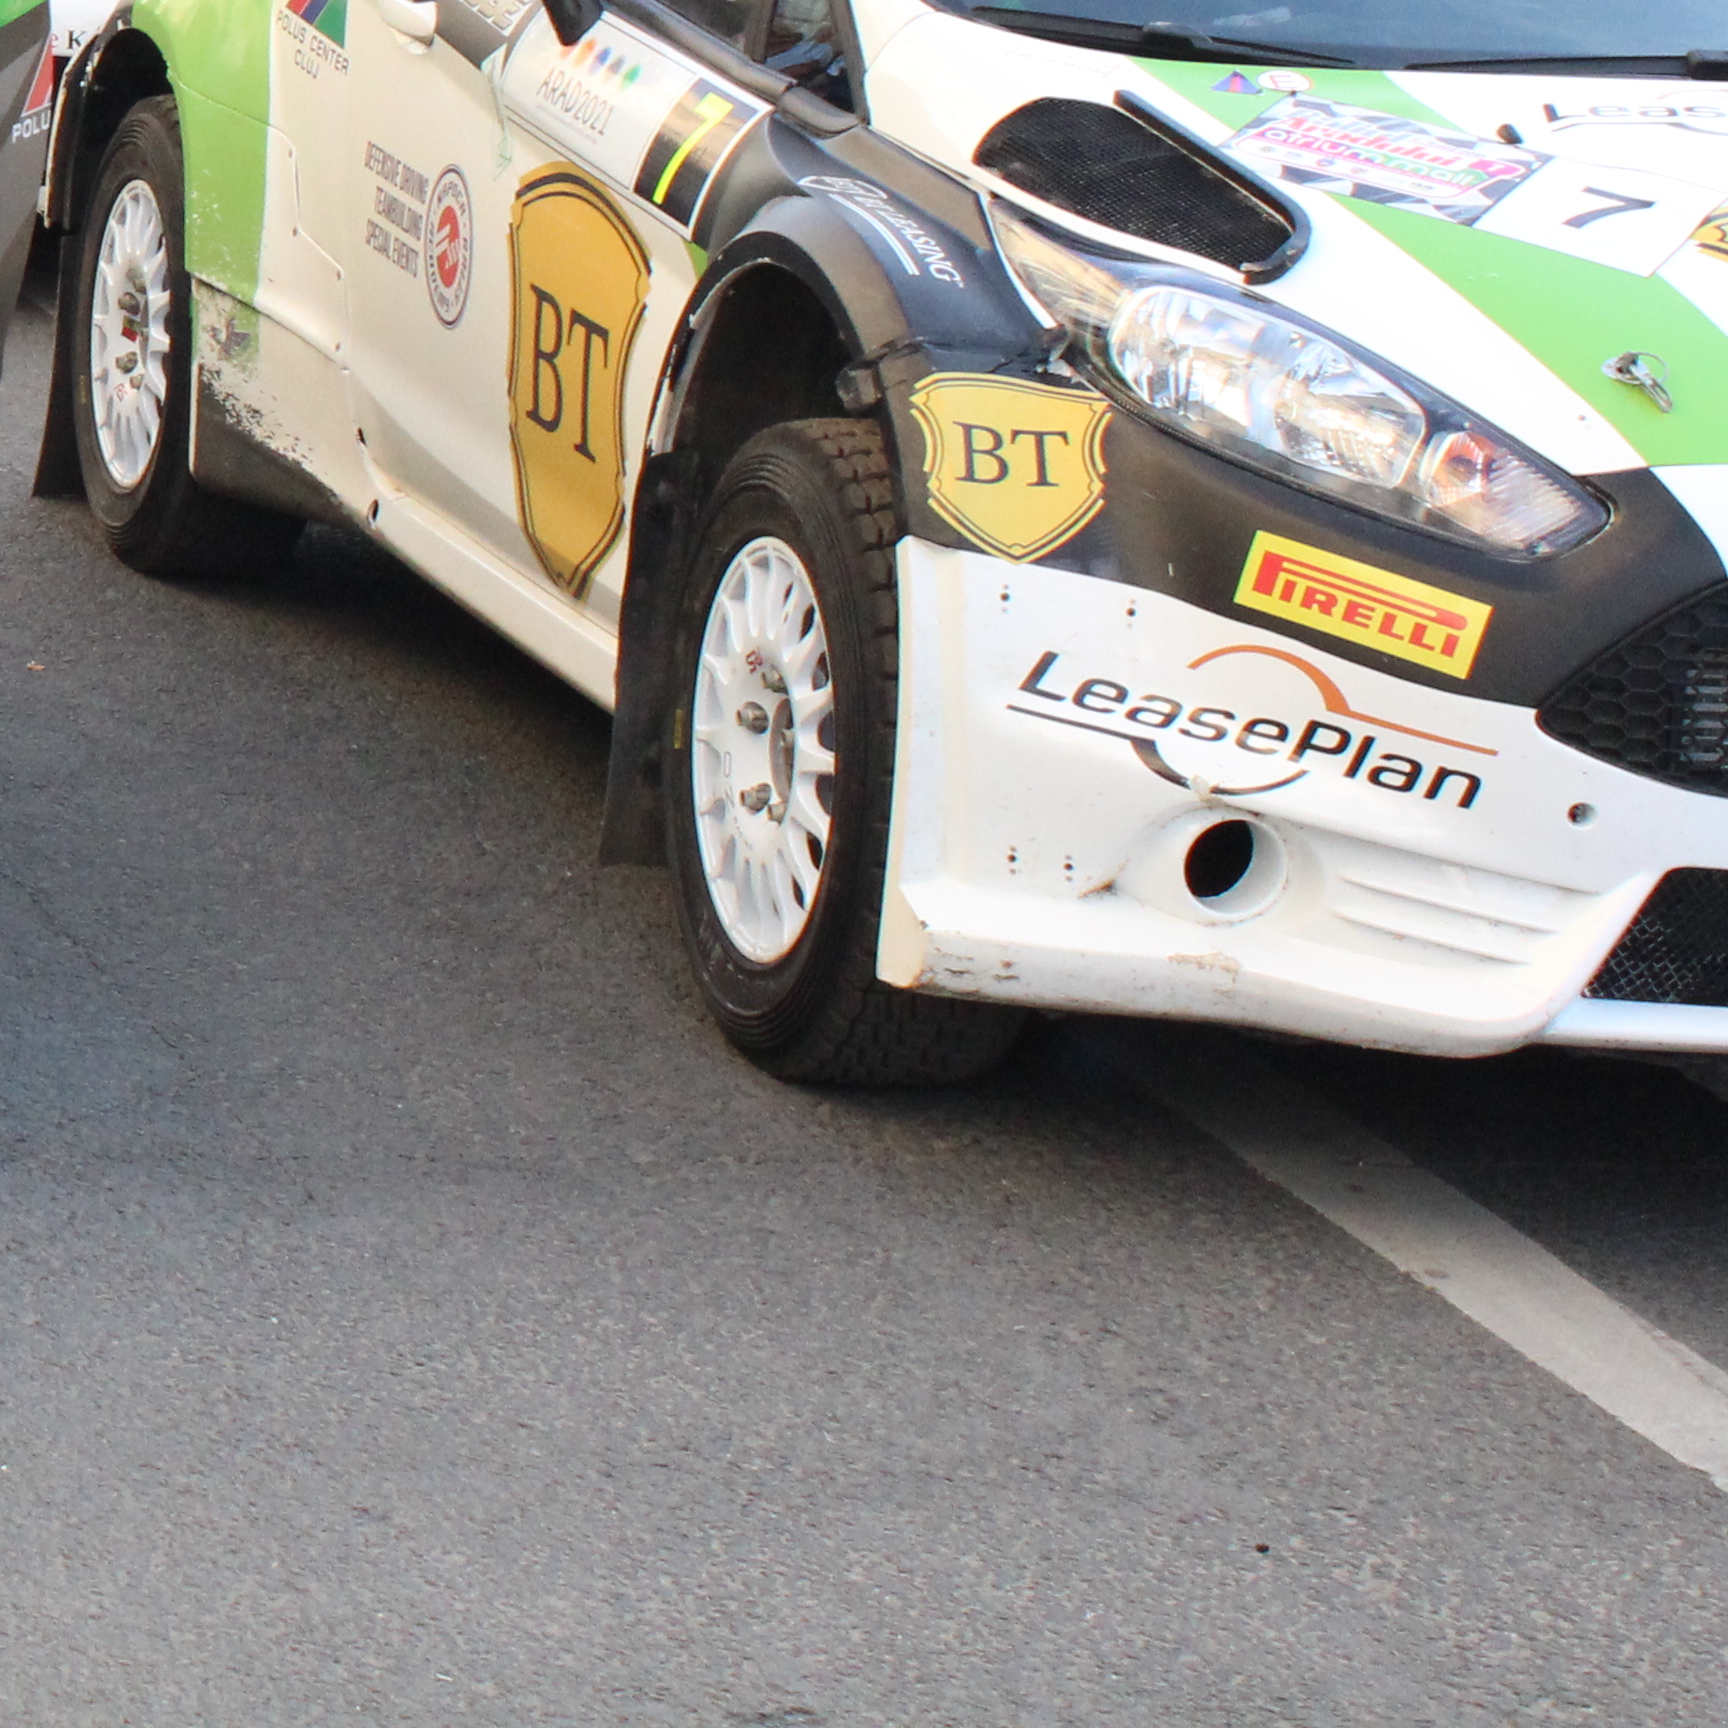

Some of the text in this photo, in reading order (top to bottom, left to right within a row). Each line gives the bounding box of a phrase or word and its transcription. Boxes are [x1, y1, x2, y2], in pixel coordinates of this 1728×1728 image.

[275, 8, 351, 77] POLUS CENTER
[294, 49, 320, 80] CLUJ
[11, 110, 52, 144] POLU
[536, 67, 613, 136] ARAD2021
[1542, 103, 1727, 123] Leas
[652, 92, 734, 206] 7
[1561, 186, 1656, 229] 7
[876, 208, 965, 288] LEASING
[527, 283, 611, 465] BT
[952, 420, 1070, 490] BT
[1251, 550, 1469, 661] PIRELLI
[1020, 651, 1482, 810] LeasePlan
